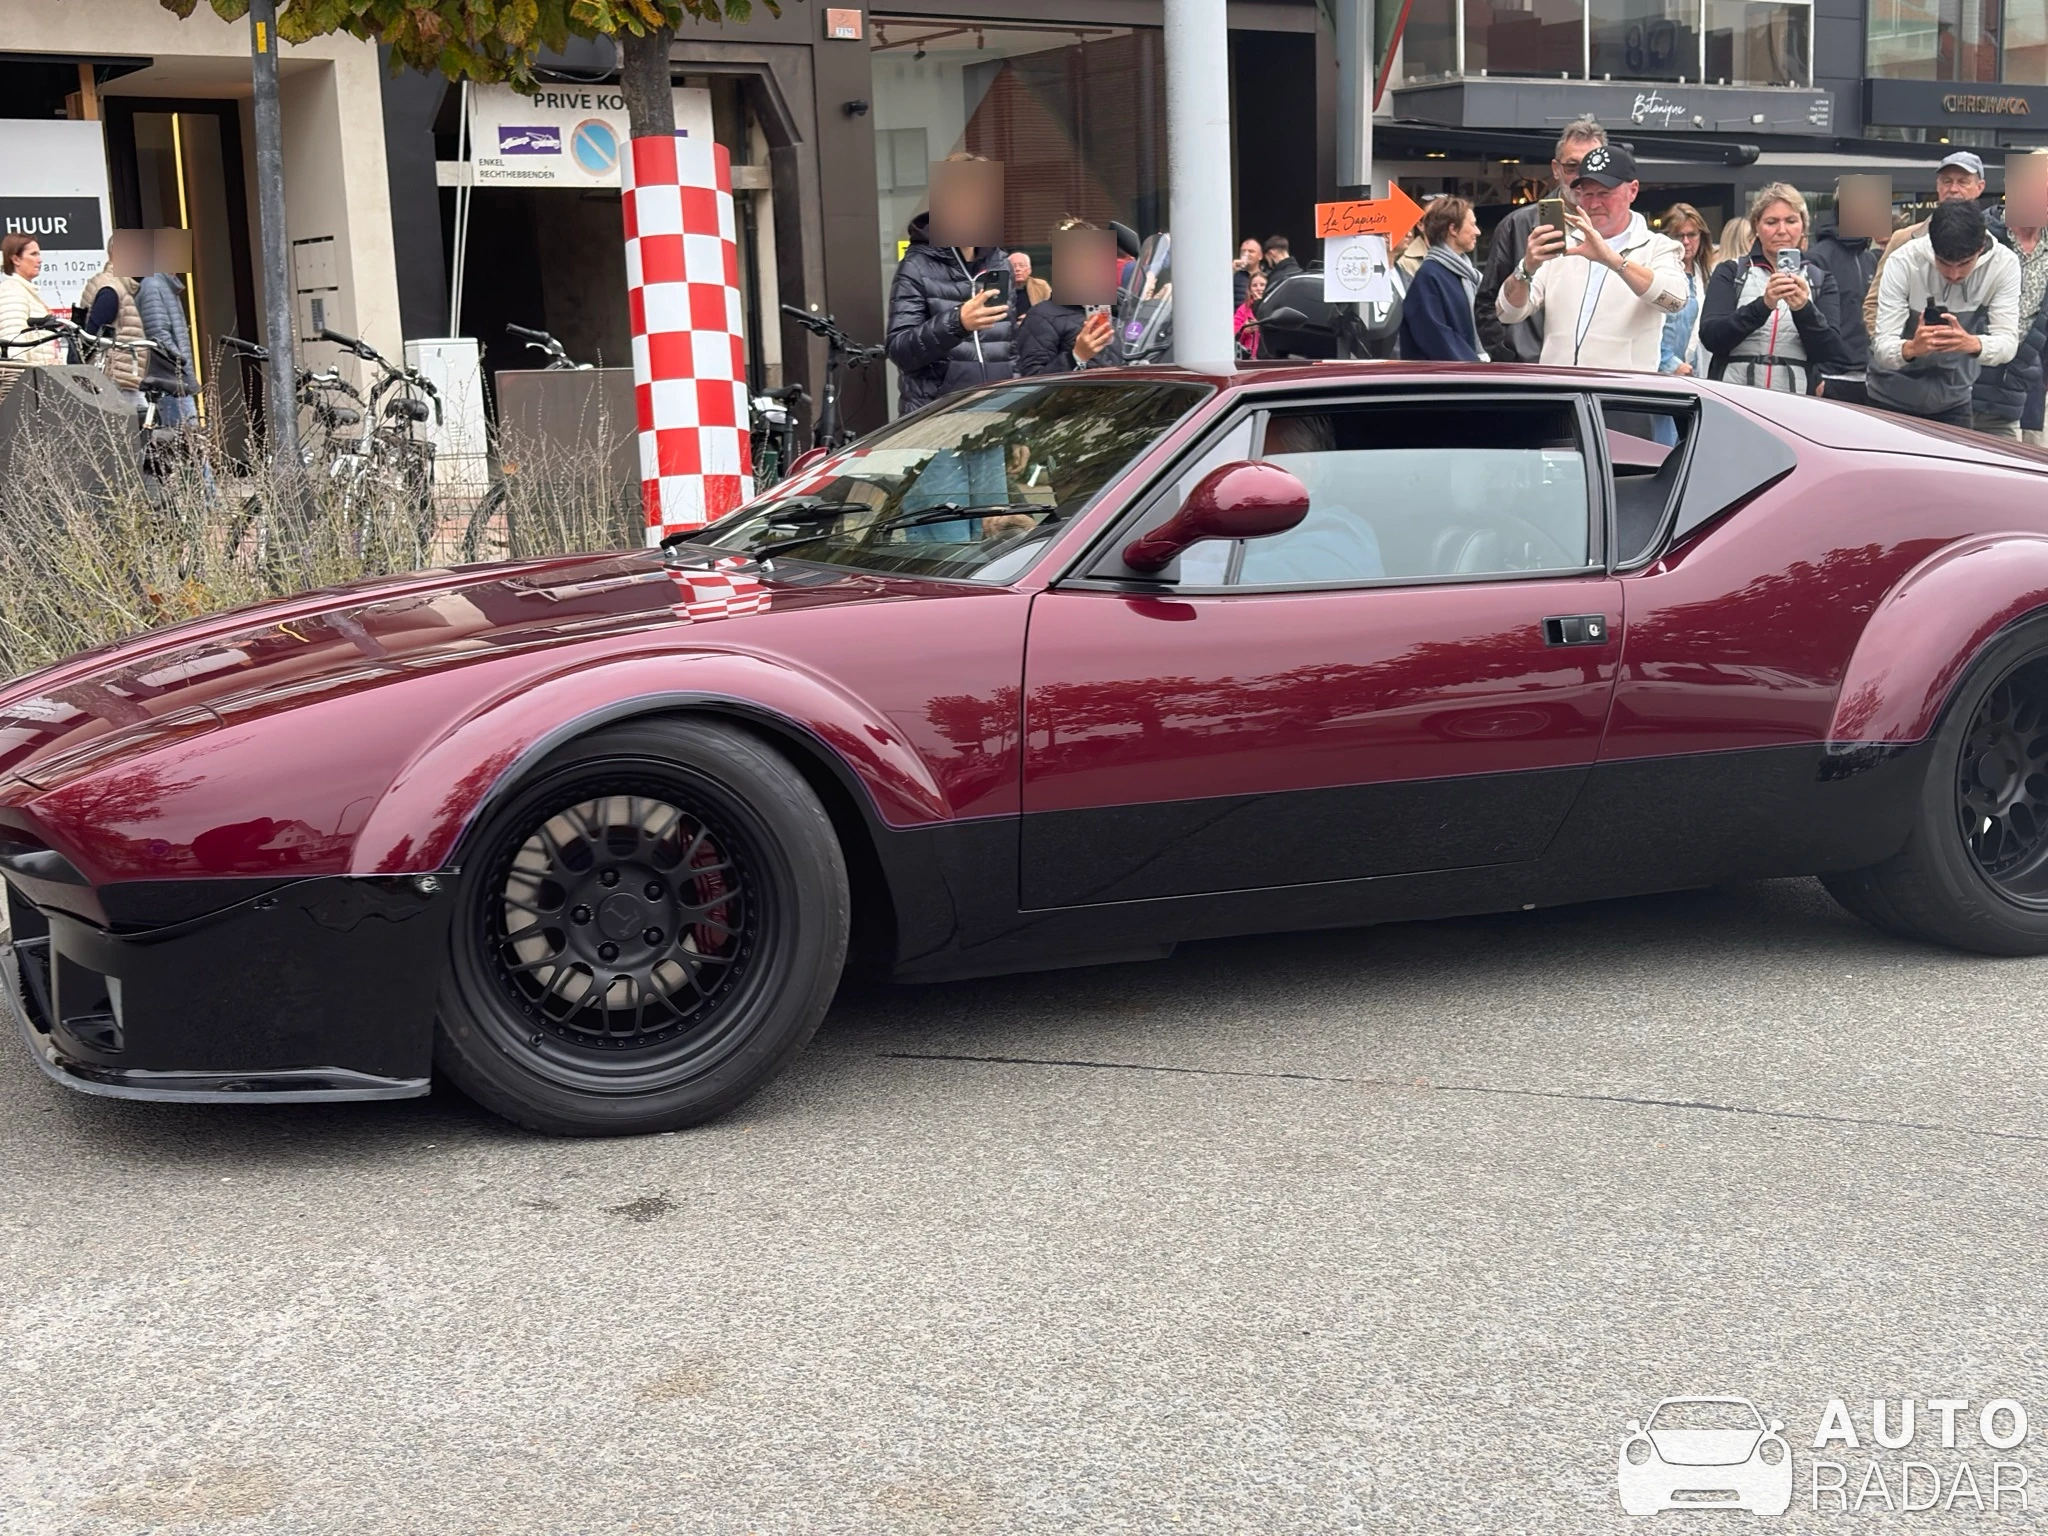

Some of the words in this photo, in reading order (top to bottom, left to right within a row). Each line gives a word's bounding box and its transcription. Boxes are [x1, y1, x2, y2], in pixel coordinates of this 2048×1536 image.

[534, 92, 591, 110] PRIVE
[597, 94, 627, 111] KO
[1630, 89, 1687, 127] Botanique
[479, 158, 505, 167] ENKEL
[480, 170, 555, 179] RECHTHEBBENDEN
[5, 216, 68, 235] HUUR
[1323, 206, 1340, 234] La
[39, 263, 58, 272] an
